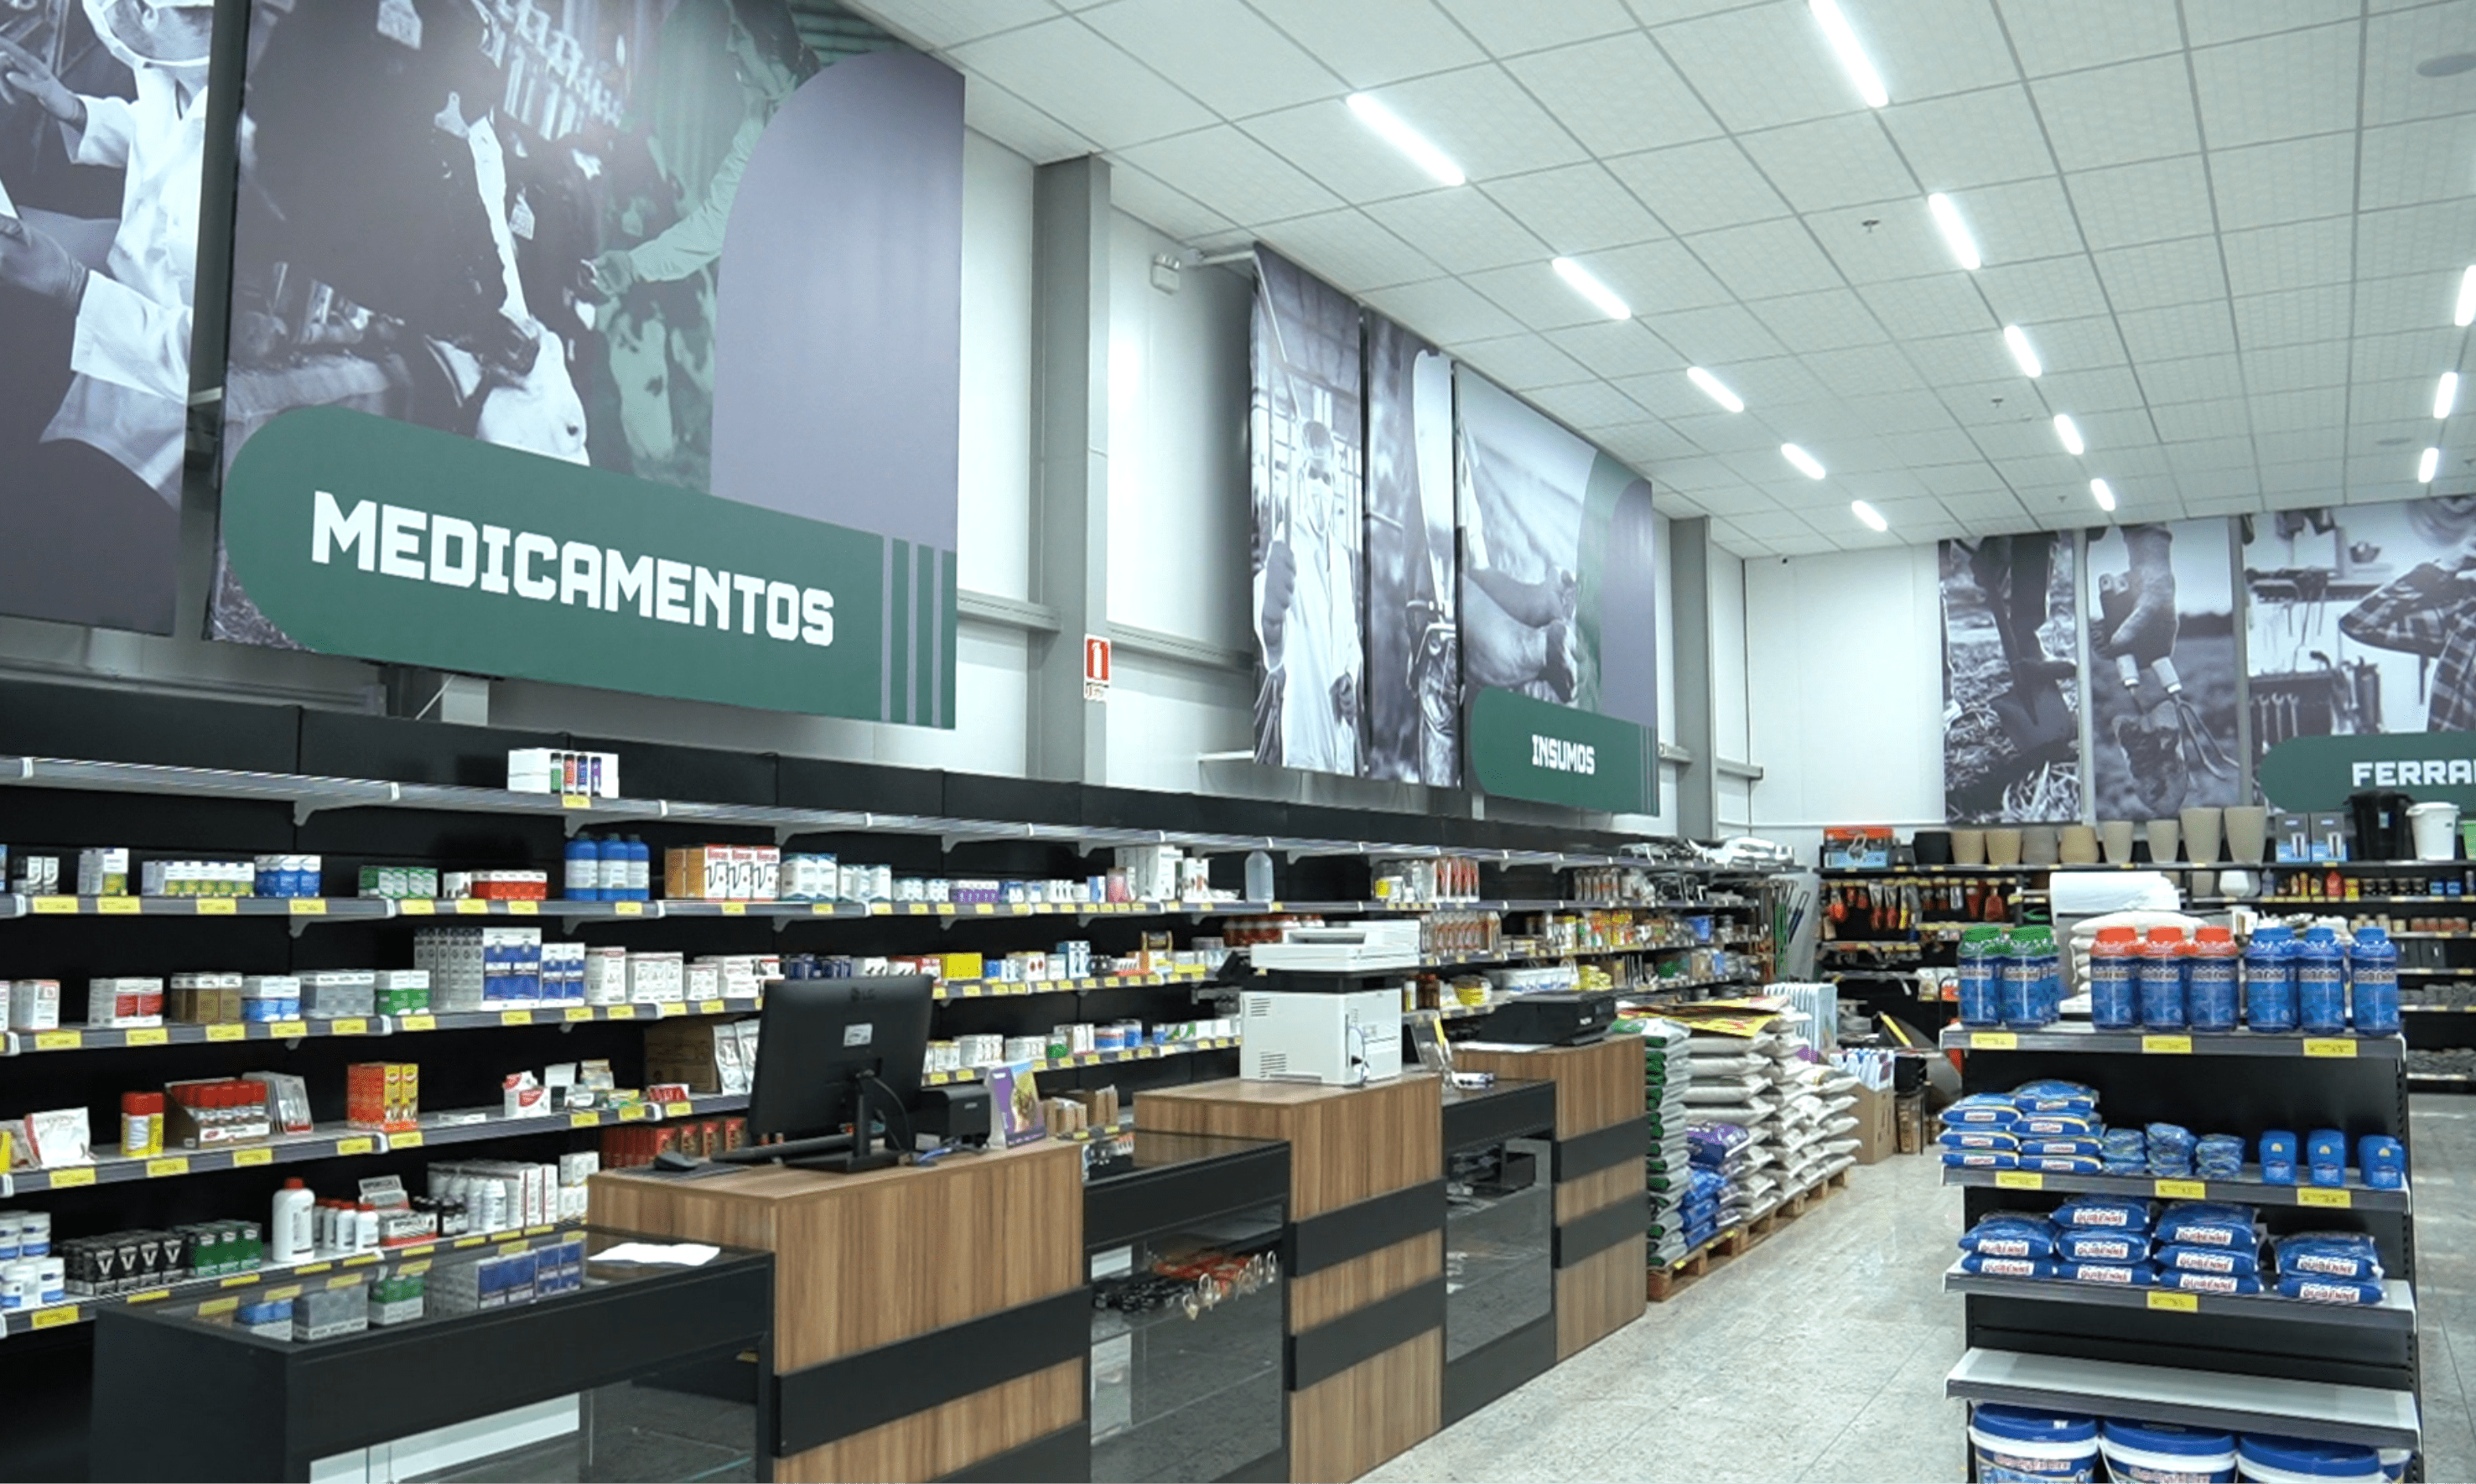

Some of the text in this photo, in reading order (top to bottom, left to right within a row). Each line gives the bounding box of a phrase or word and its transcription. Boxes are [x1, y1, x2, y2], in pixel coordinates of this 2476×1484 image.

[311, 490, 834, 646] MEDICAMENTOS
[1531, 734, 1596, 776] INSUMOS
[2352, 759, 2476, 787] FERRA
